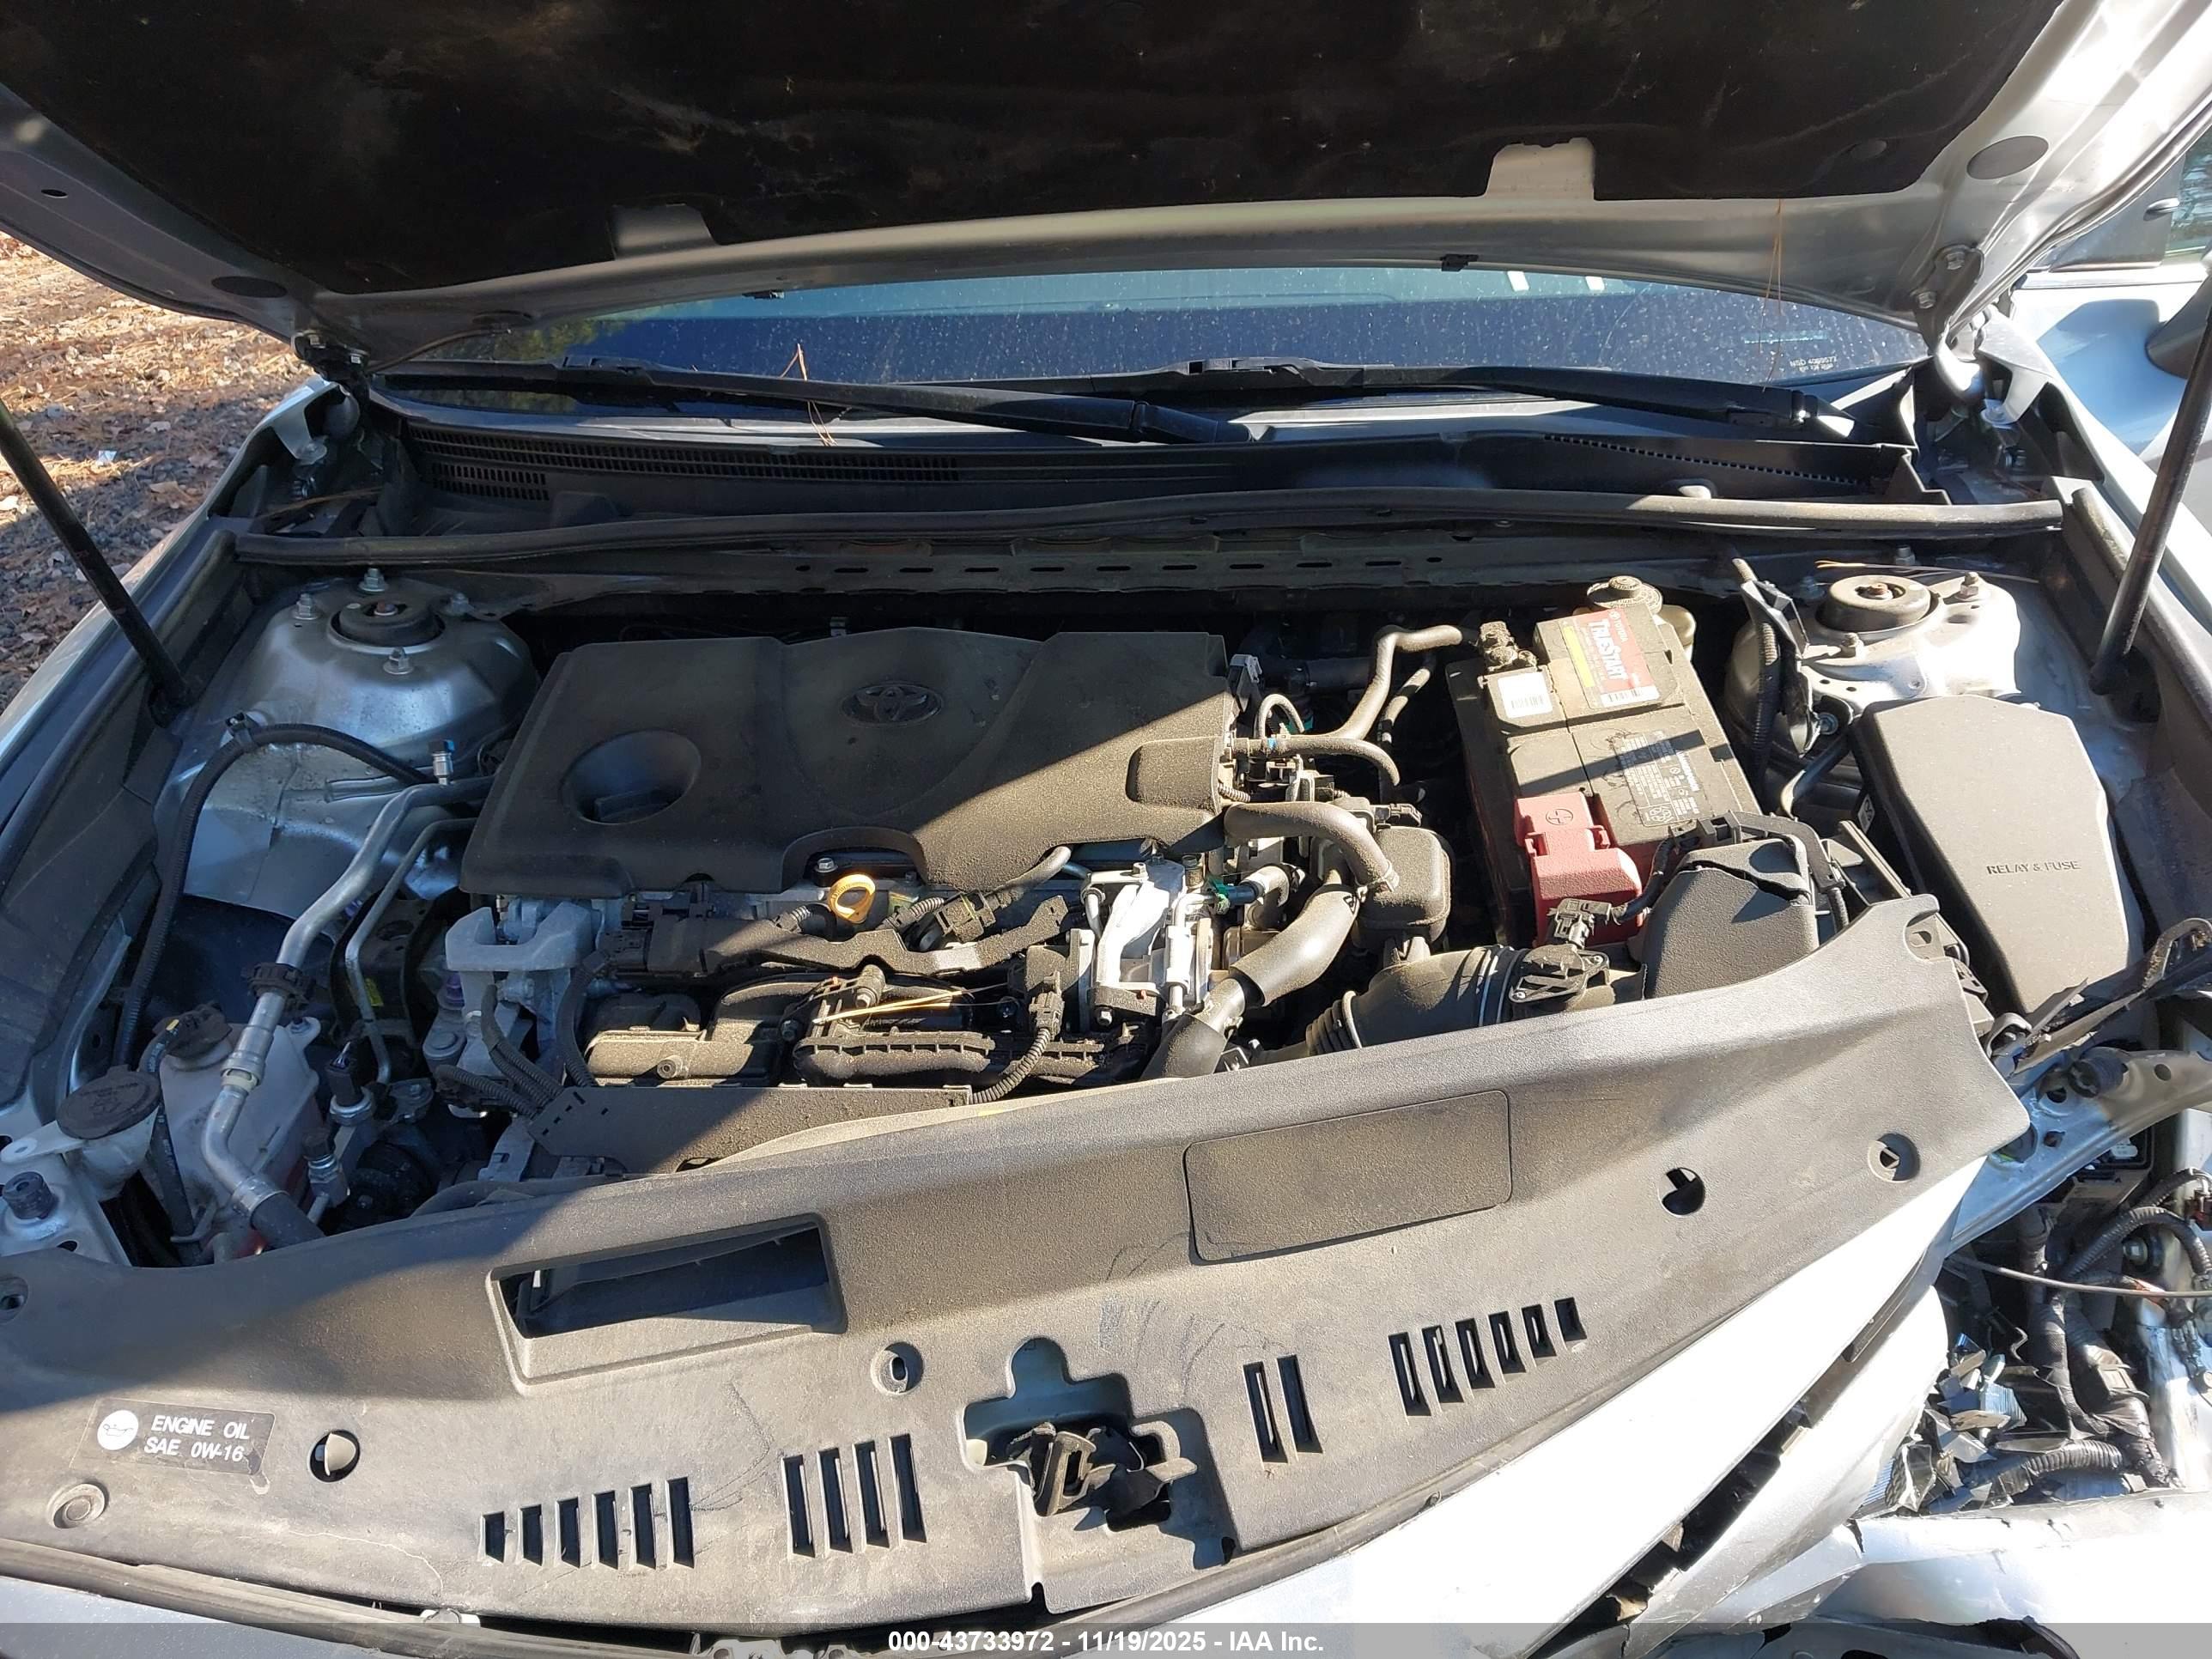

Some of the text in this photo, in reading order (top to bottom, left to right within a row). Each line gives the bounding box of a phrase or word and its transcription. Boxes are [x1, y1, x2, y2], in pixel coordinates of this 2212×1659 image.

[1986, 860, 2081, 874] RELAY & FUSE
[150, 1415, 250, 1440] ENGINE OIL
[143, 1436, 245, 1462] SAE 0W-16
